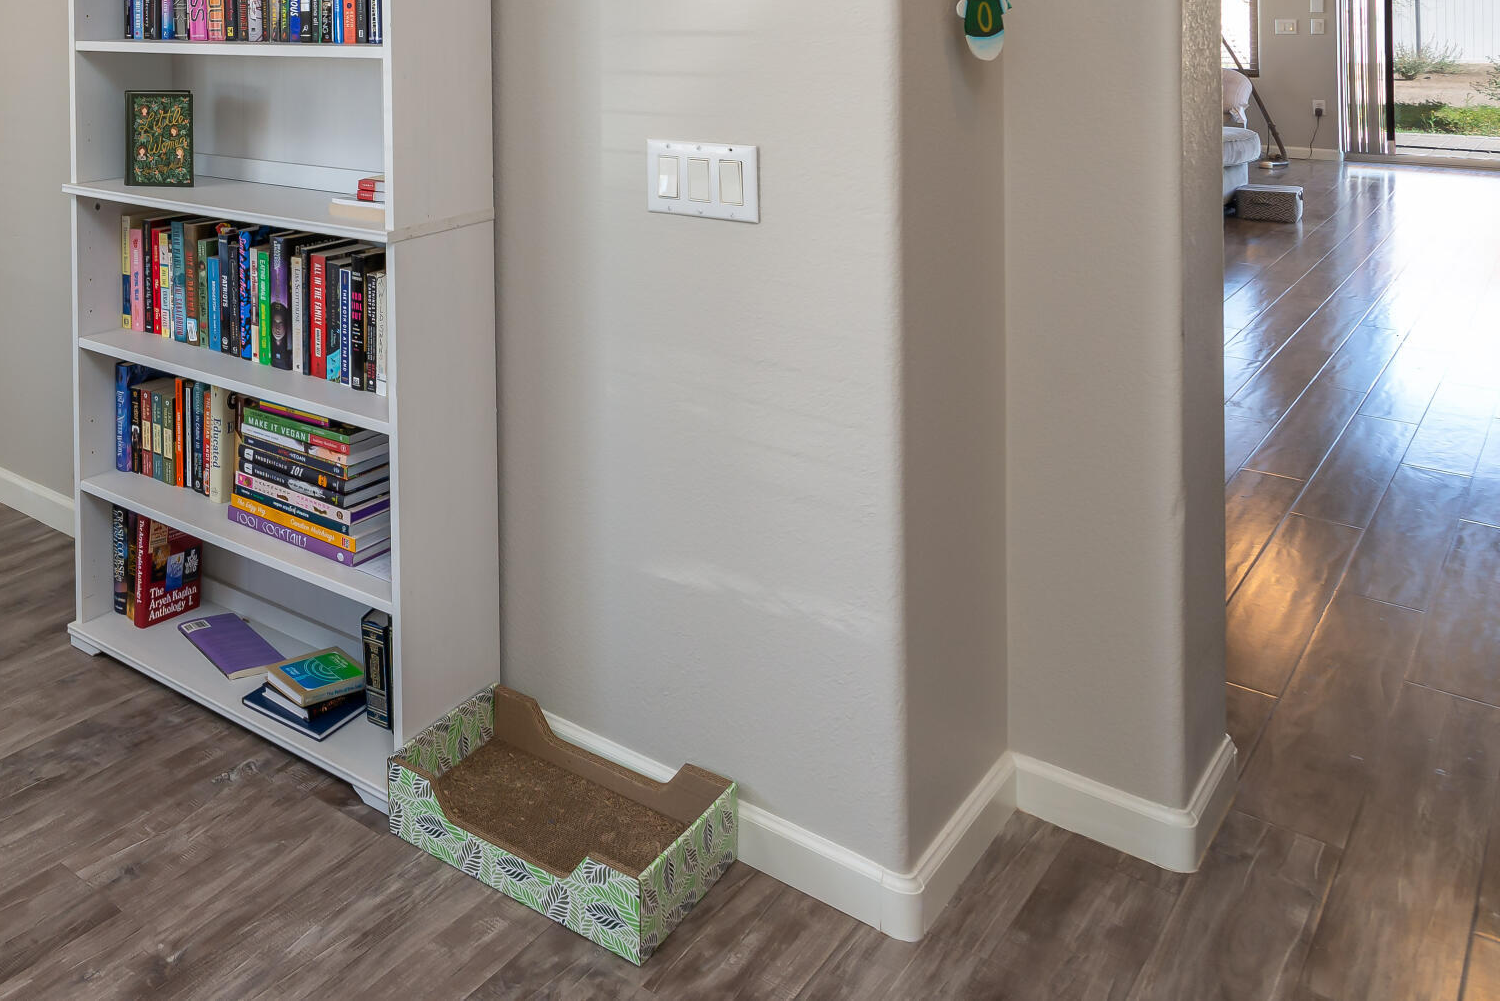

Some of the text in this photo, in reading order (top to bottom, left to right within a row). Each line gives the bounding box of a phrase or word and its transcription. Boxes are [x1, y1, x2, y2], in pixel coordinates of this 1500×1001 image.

[138, 107, 185, 133] Little
[143, 133, 189, 154] Women
[314, 263, 322, 275] ALL
[314, 277, 322, 285] IN
[314, 287, 322, 299] THE
[314, 301, 322, 325] FAMILY
[248, 416, 268, 429] MAKE
[280, 427, 306, 441] VEGAN
[213, 418, 221, 468] Educated
[290, 465, 304, 477] 101
[245, 501, 257, 513] Edgy
[236, 511, 308, 547] 1001 COCKTAILS
[150, 585, 164, 599] The
[150, 585, 197, 611] Aryeh Kaplan
[148, 599, 186, 621] Anthology
